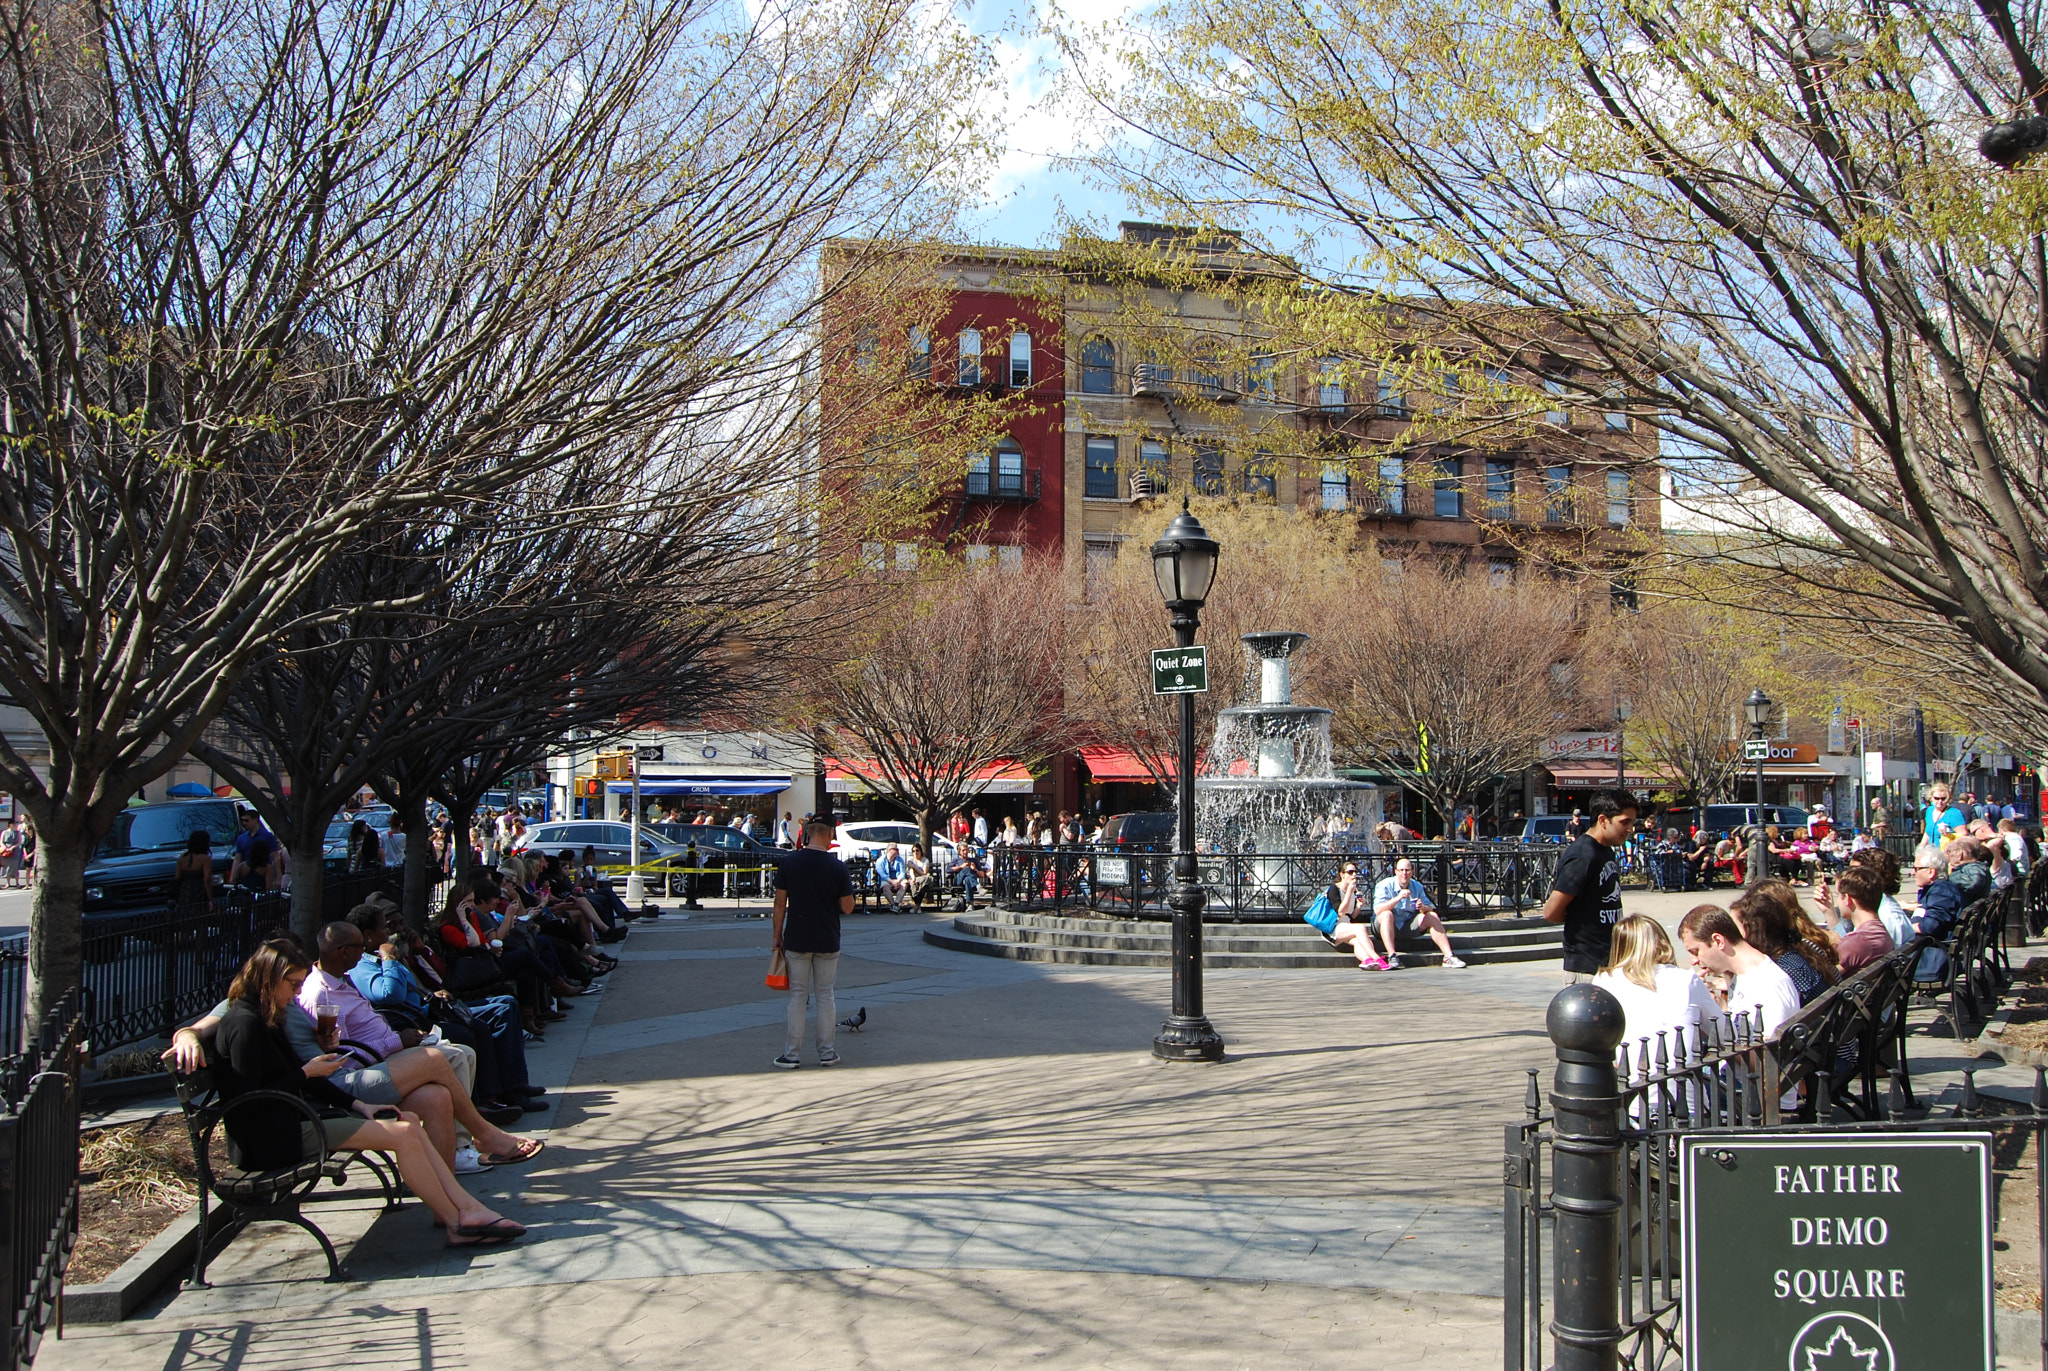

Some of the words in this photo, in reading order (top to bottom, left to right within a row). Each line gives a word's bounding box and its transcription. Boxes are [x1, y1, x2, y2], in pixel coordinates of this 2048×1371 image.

[1155, 657, 1179, 672] Quiet
[1181, 655, 1203, 668] Zone
[642, 750, 657, 758] WAY
[1774, 1164, 1902, 1193] FATHER
[1789, 1216, 1889, 1246] DEMO
[1773, 1268, 1906, 1305] SQUARE
